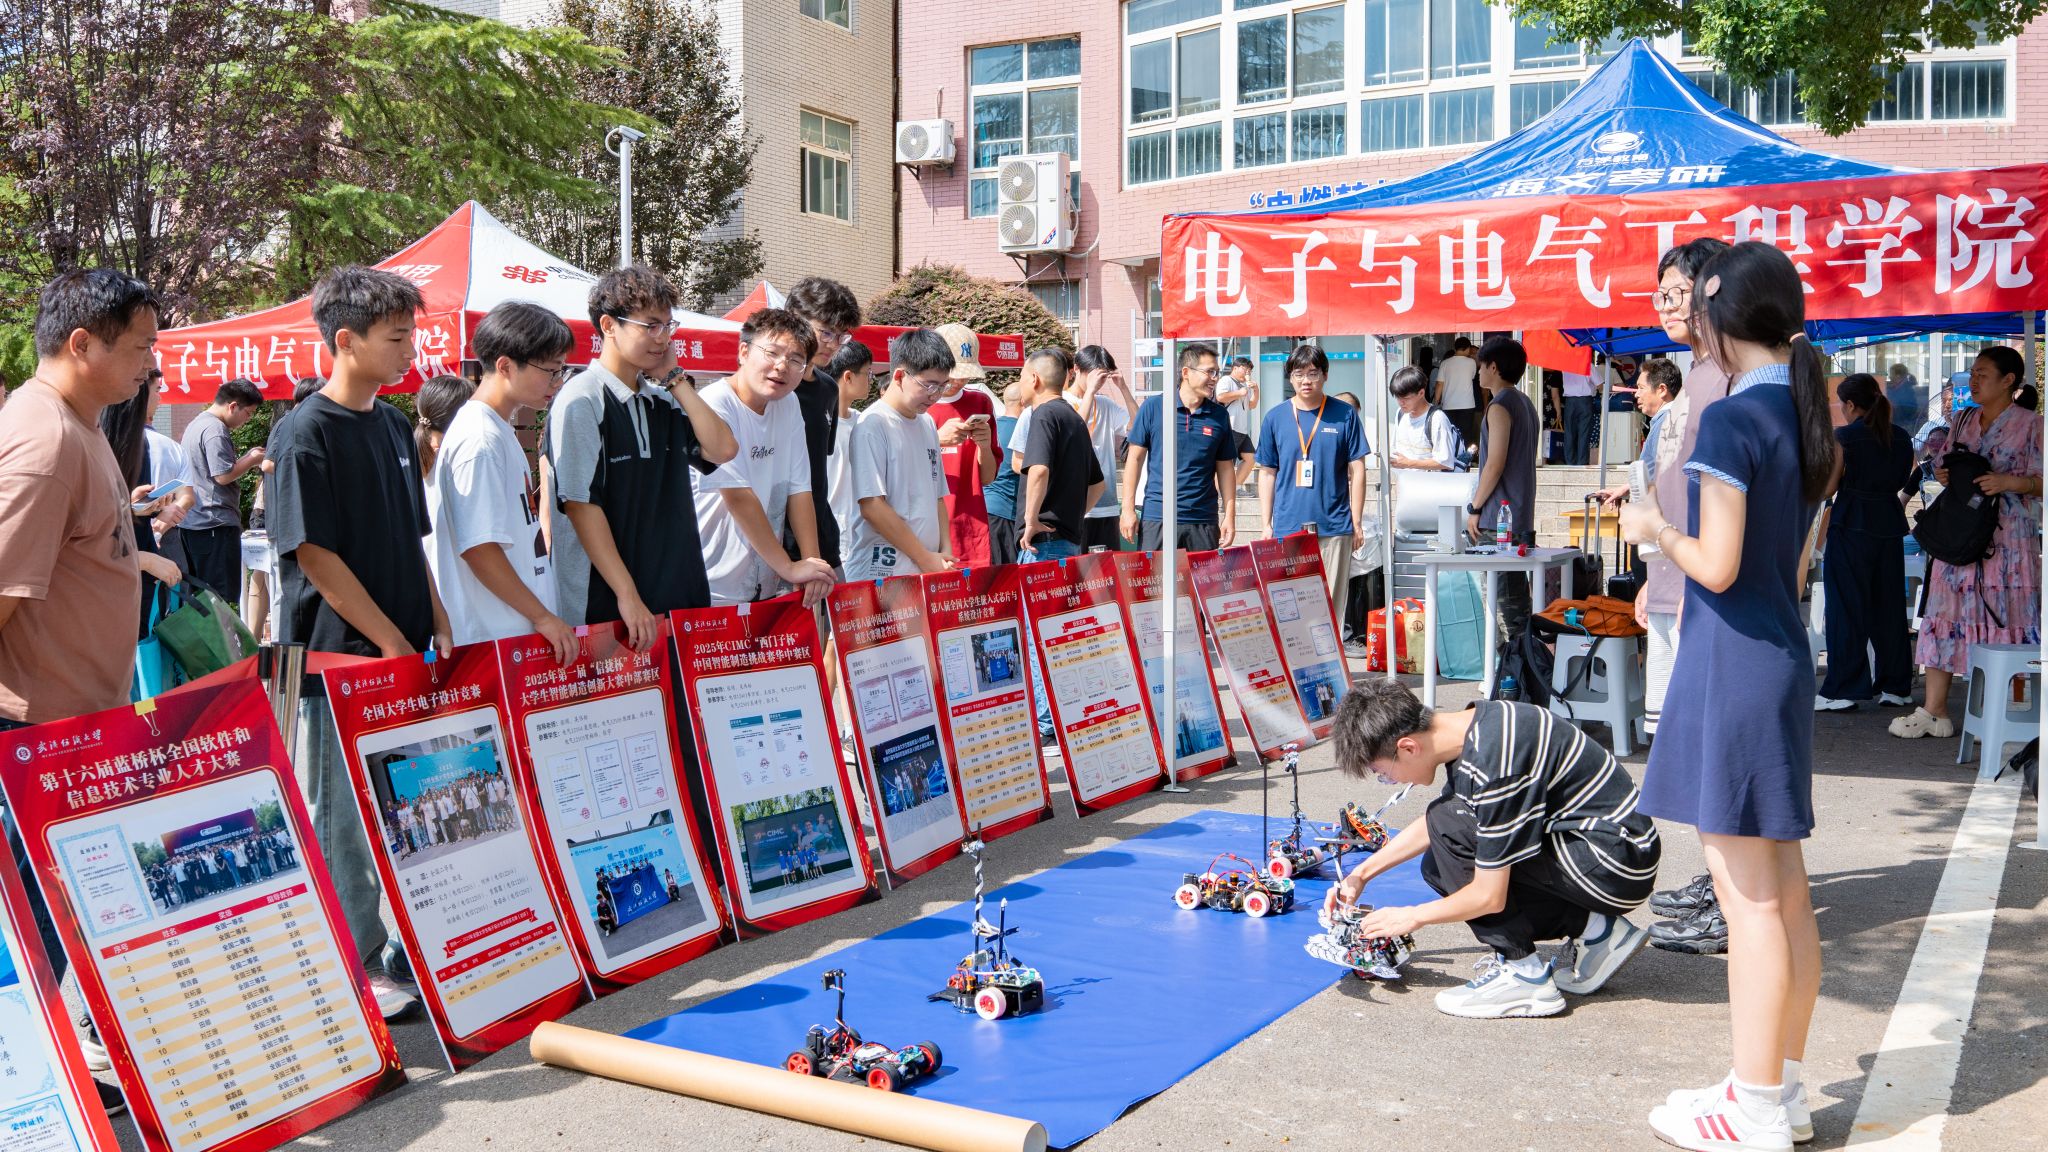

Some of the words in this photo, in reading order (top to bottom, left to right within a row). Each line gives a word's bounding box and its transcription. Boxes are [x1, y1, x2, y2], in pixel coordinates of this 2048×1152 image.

[1491, 164, 1728, 198] 海文考研
[674, 339, 704, 359] 联通
[930, 590, 1018, 614] 第八届全国大学生嵌入式芯片与
[958, 607, 995, 623] 系统设计竞赛
[693, 646, 811, 672] 中国智能制造挑战赛华中赛区
[362, 683, 482, 722] 全国大学生电子设计竞赛
[519, 666, 661, 707] 大学生智能制造创新大赛中部赛区
[39, 727, 251, 793] 第十六届蓝桥杯全国软件和
[67, 751, 241, 809] 信息技术专业人才大赛
[112, 942, 129, 953] 序号
[161, 927, 177, 939] 姓名
[266, 888, 293, 904] 指导教师
[213, 917, 245, 930] 全国一等奖
[217, 926, 248, 940] 全国二等奖
[221, 936, 252, 949] 全国二等奖
[225, 946, 256, 959] 全国二等奖
[229, 956, 260, 969] 全国二等奖
[233, 966, 264, 979] 全国三等奖
[237, 975, 268, 989] 全国三等奖
[241, 985, 271, 999] 全国三等奖
[245, 995, 275, 1009] 全国三等奖
[157, 1047, 167, 1055] 10
[249, 1005, 279, 1019] 全国三等奖
[162, 1057, 172, 1066] 11
[253, 1015, 283, 1029] 全国三等奖
[166, 1068, 176, 1076] 12
[257, 1025, 287, 1039] 全国三等奖
[170, 1078, 180, 1087] 13
[261, 1035, 291, 1049] 全国三等奖
[174, 1088, 185, 1097] 14
[264, 1044, 295, 1059] 全国三等奖
[179, 1099, 189, 1108] 15
[268, 1054, 298, 1069] 全国三等奖
[183, 1109, 193, 1118] 16
[272, 1064, 302, 1079] 全国三等奖
[187, 1120, 198, 1128] 17
[276, 1074, 306, 1089] 全国三等奖
[11, 1115, 44, 1131] 荣誉证书
[192, 1130, 202, 1139] 18
[280, 1084, 310, 1099] 全国三等奖
